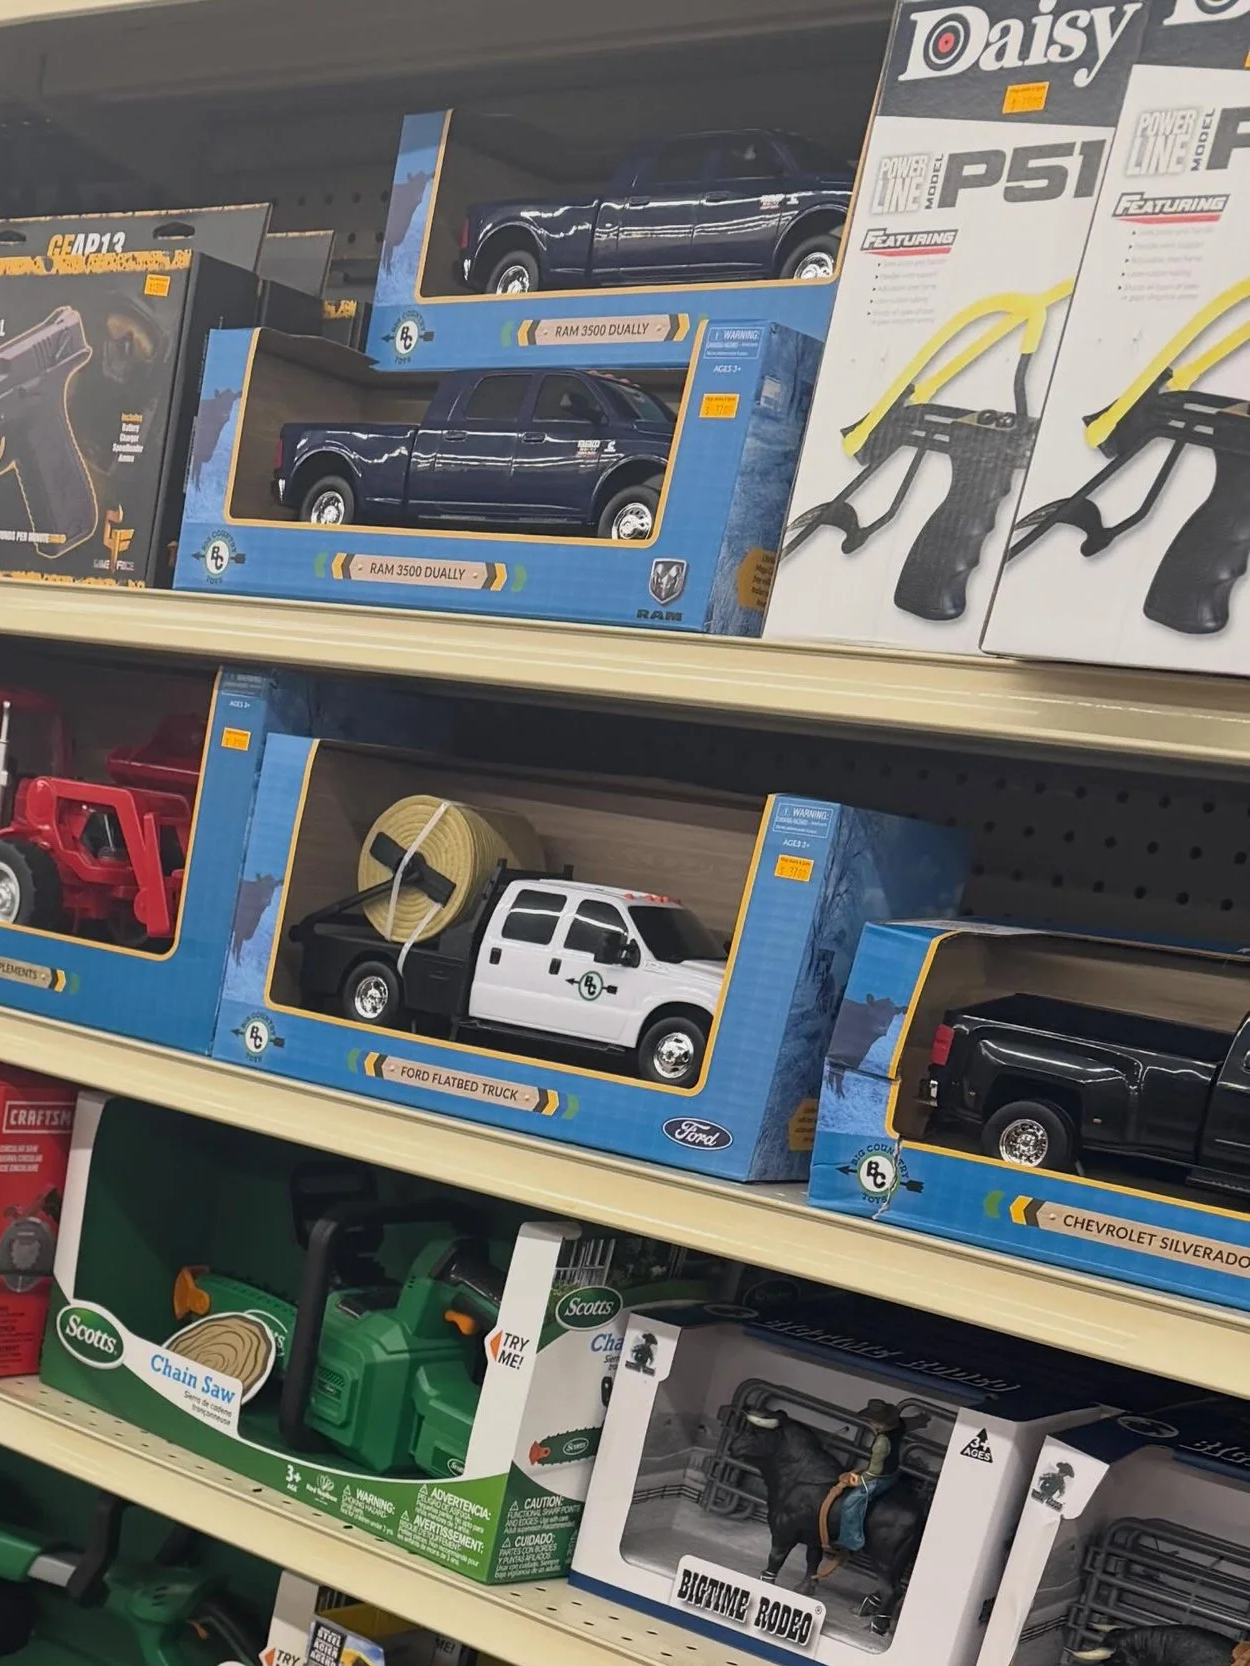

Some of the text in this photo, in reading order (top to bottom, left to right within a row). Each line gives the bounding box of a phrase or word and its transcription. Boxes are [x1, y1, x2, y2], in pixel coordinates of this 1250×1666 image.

[898, 0, 1146, 88] Daisy
[1138, 110, 1197, 138] POWER
[1190, 107, 1216, 171] MODEL
[879, 155, 929, 179] POWER
[1126, 135, 1188, 175] LINE
[925, 153, 944, 210] MODEL
[937, 139, 1107, 209] P51
[870, 177, 925, 214] LINE
[1112, 192, 1232, 217] FEATURING
[862, 229, 958, 251] FEATURING
[555, 321, 650, 338] RAM 3500 DUALLY
[370, 560, 467, 582] RAM 3500 DUALLY
[636, 609, 682, 622] RAM
[400, 1065, 518, 1102] FORD FLATBED TRUCK
[10, 1108, 72, 1127] CRAFTSM
[678, 1119, 720, 1149] Ford
[1063, 1214, 1250, 1271] CHEVROLET SILVERADO
[565, 1296, 613, 1317] Scotts
[65, 1316, 117, 1355] Scotts
[502, 1331, 530, 1352] TRY
[497, 1351, 524, 1371] ME!
[150, 1353, 237, 1405] Chain Saw
[963, 1448, 991, 1462] AGES
[285, 1464, 301, 1483] 3+
[356, 1487, 396, 1515] WARNING:
[430, 1487, 492, 1521] ADVERTENCIA:
[524, 1495, 564, 1510] CAUTION:
[413, 1514, 484, 1554] AVERTISSEMENT:
[514, 1532, 556, 1548] CUIDADO:
[676, 1569, 815, 1646] BIGTIME RODEO
[275, 1648, 300, 1666] TRY
